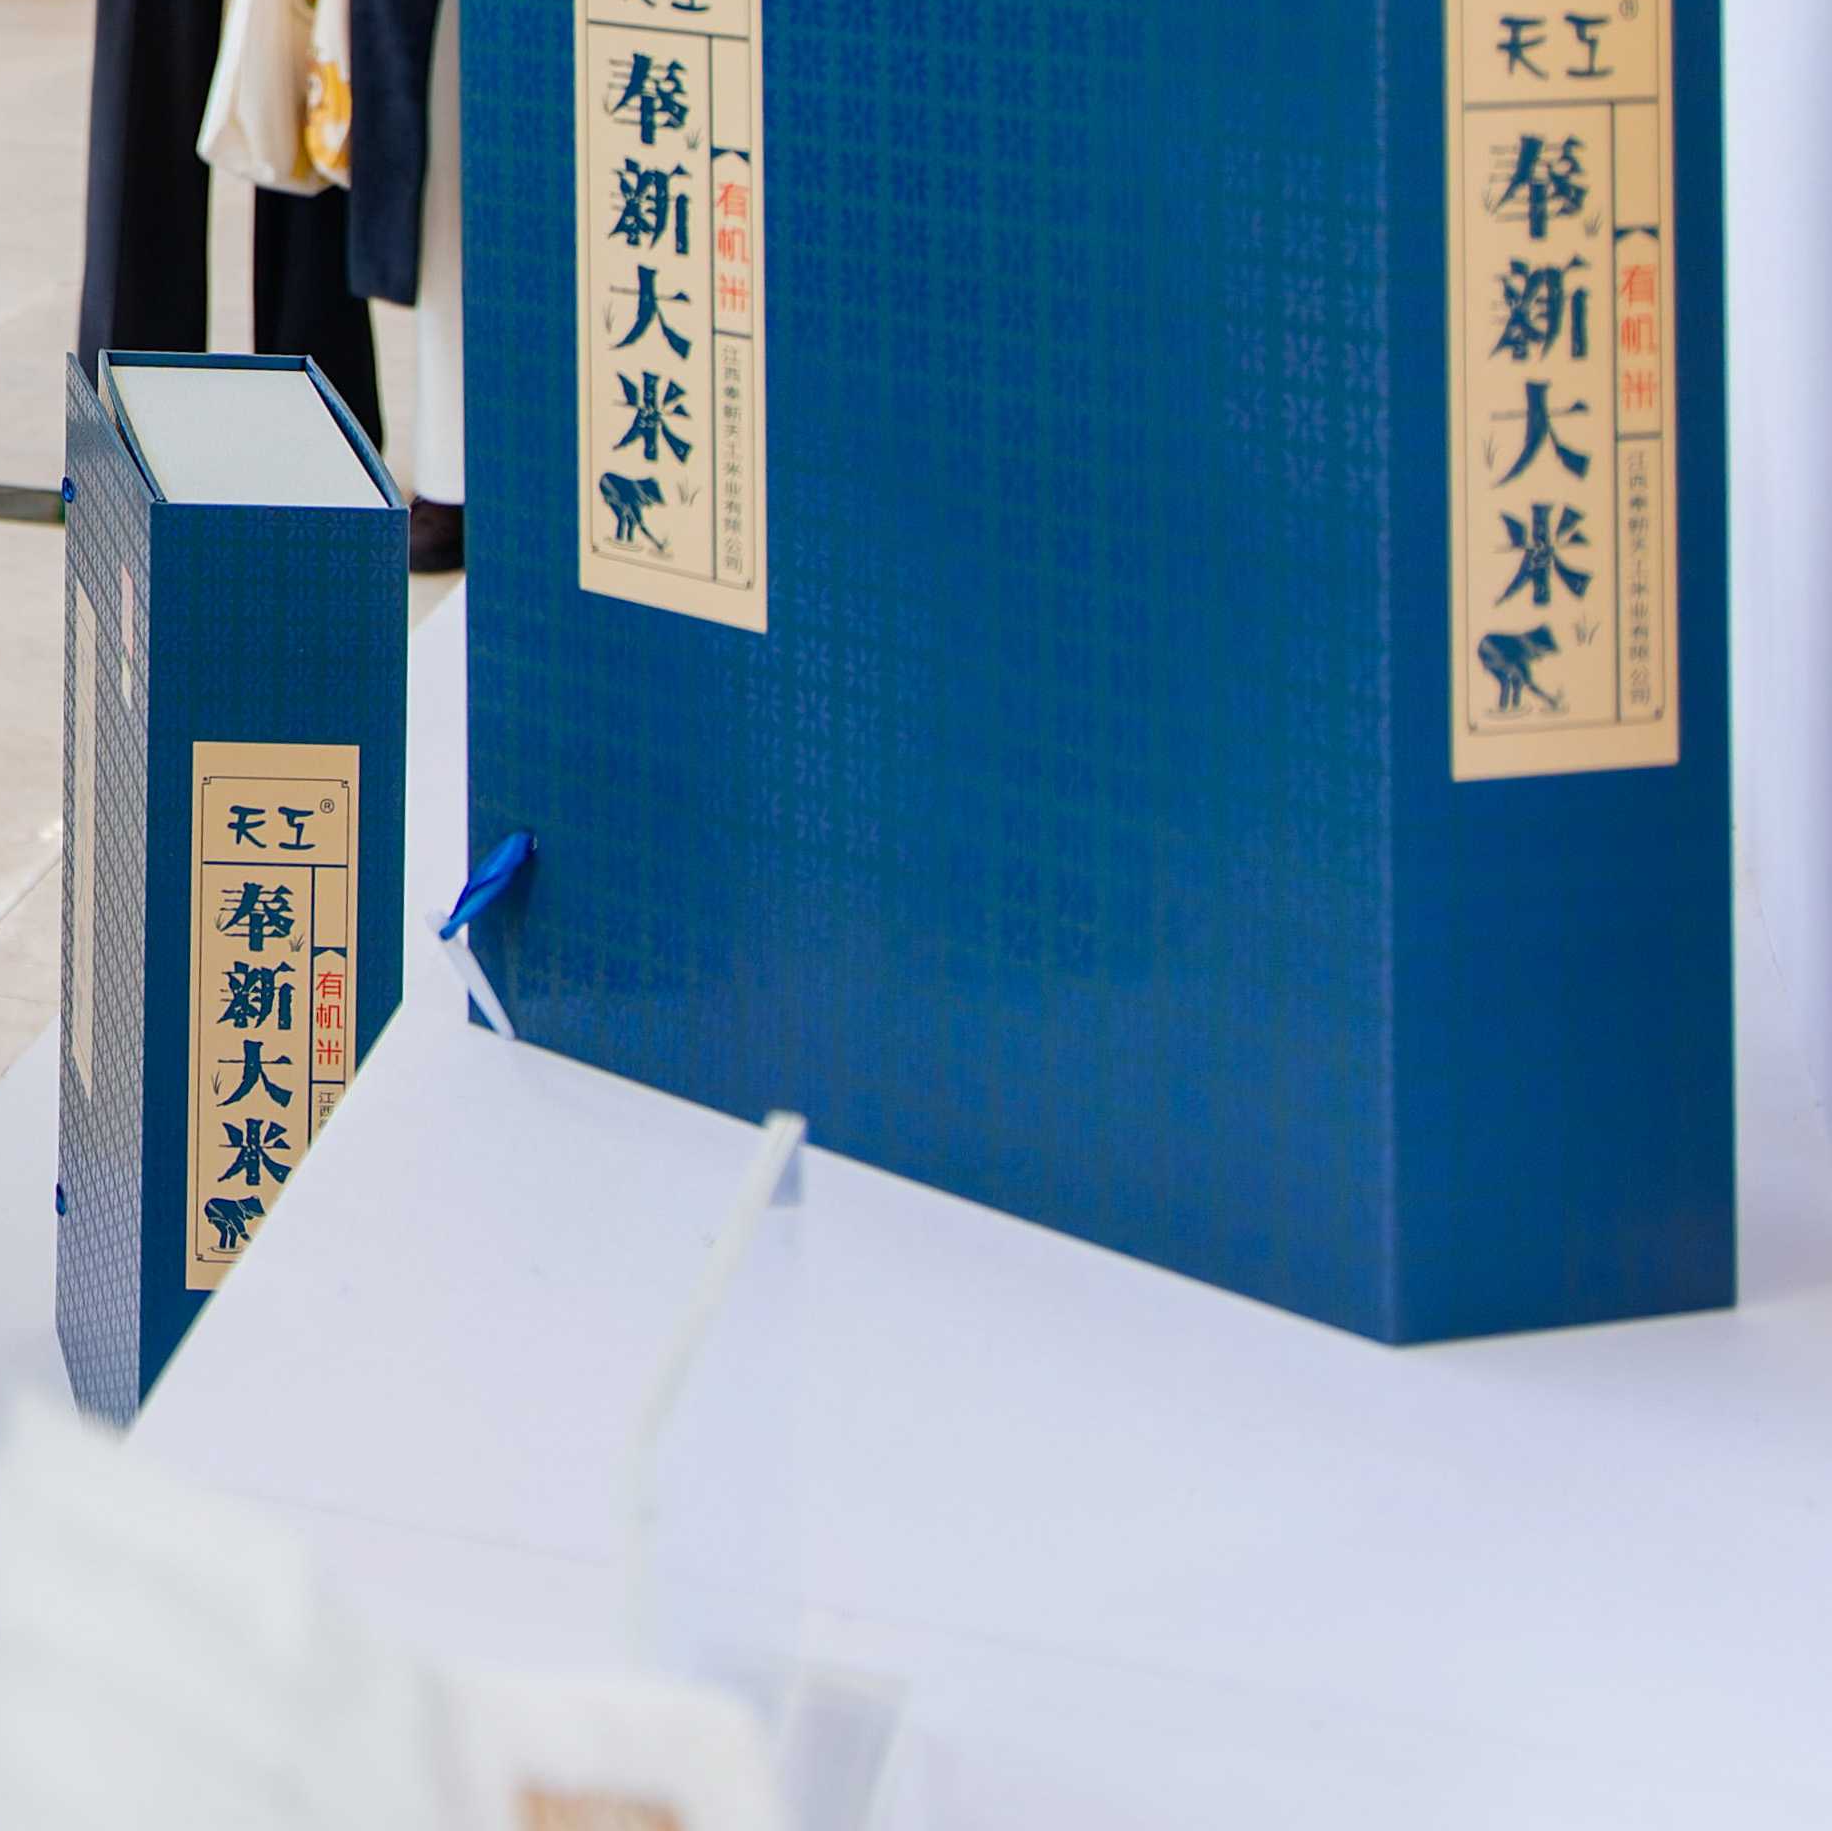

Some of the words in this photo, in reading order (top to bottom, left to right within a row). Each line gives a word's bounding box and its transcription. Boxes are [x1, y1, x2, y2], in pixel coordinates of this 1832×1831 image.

[605, 52, 694, 465] 奉新大米
[716, 181, 751, 313] 有机米
[1486, 132, 1594, 608] 奉新大米
[1620, 262, 1658, 411] 有机米
[227, 805, 316, 850] 天工
[216, 881, 296, 1186] 奉新大米
[315, 970, 345, 1066] 有机米
[318, 1091, 336, 1128] 江西
